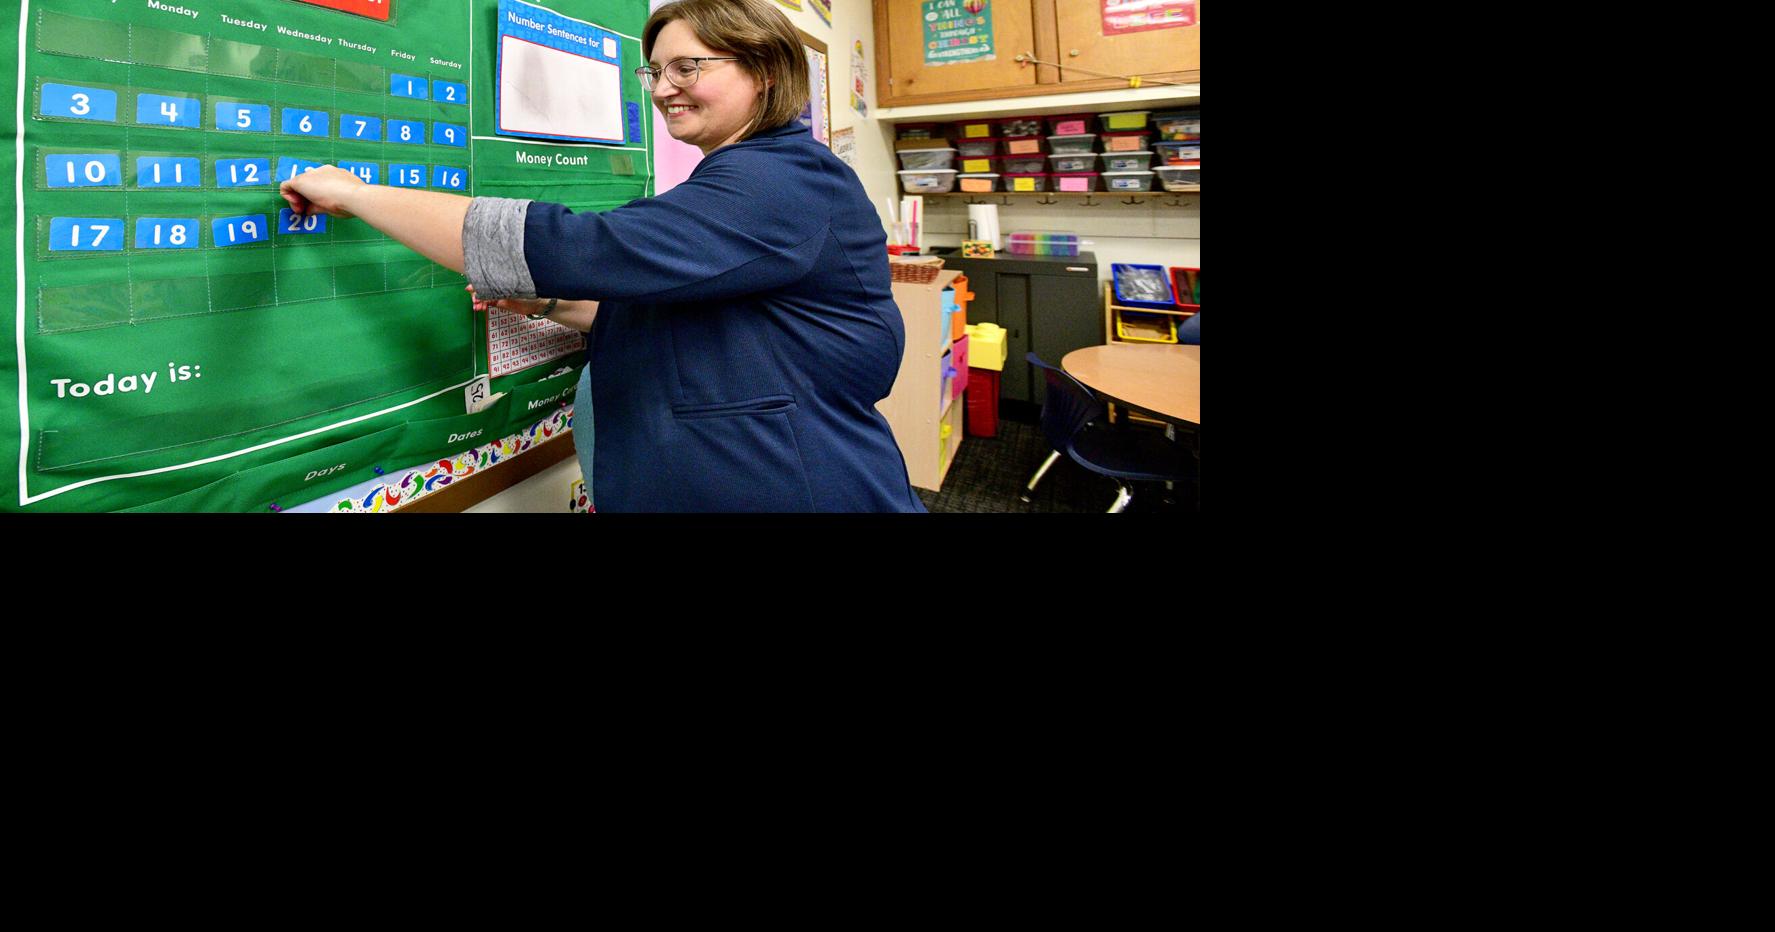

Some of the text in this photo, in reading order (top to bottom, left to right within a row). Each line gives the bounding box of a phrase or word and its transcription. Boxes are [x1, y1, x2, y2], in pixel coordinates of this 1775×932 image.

[147, 0, 461, 69] Monday Tuesday Wednesday Thursday Friday Saturday
[508, 11, 600, 48] Number Sentences for
[447, 87, 455, 100] 2
[70, 93, 454, 143] 3 4 5 6 7 8 9
[516, 151, 588, 166] Money Count
[67, 161, 105, 182] 10
[154, 163, 181, 183] 11
[231, 164, 259, 182] 12
[400, 169, 419, 184] 15
[443, 171, 459, 187] 16
[72, 214, 317, 246] 17 18 19 20
[51, 363, 200, 398] Today is:
[471, 383, 484, 403] 25
[528, 394, 560, 410] Money
[448, 429, 482, 443] Dates
[305, 464, 346, 481] Days
